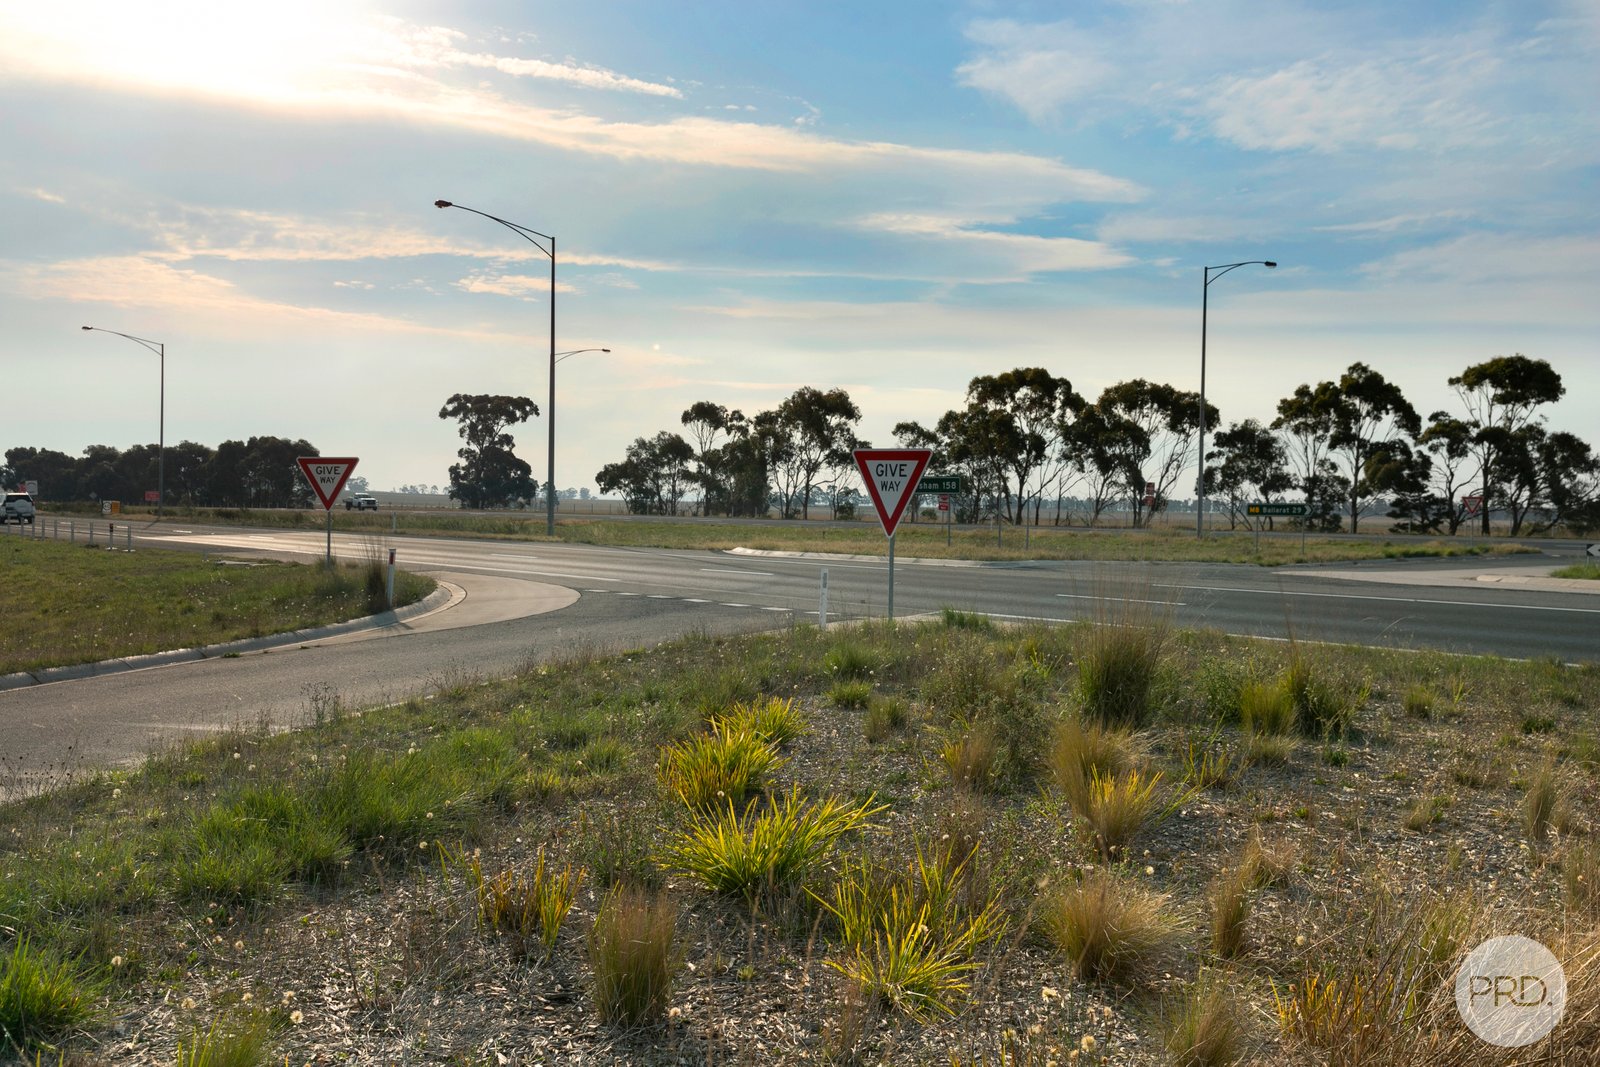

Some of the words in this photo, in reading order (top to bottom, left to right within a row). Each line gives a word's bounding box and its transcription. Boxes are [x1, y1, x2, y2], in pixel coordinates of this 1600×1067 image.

[315, 466, 341, 475] GIVE
[875, 463, 908, 477] GIVE
[319, 476, 336, 484] WAY
[880, 480, 901, 492] WAY
[918, 482, 939, 490] sham
[942, 481, 957, 490] 158
[1262, 506, 1290, 514] Ballarat
[1292, 506, 1302, 514] 29
